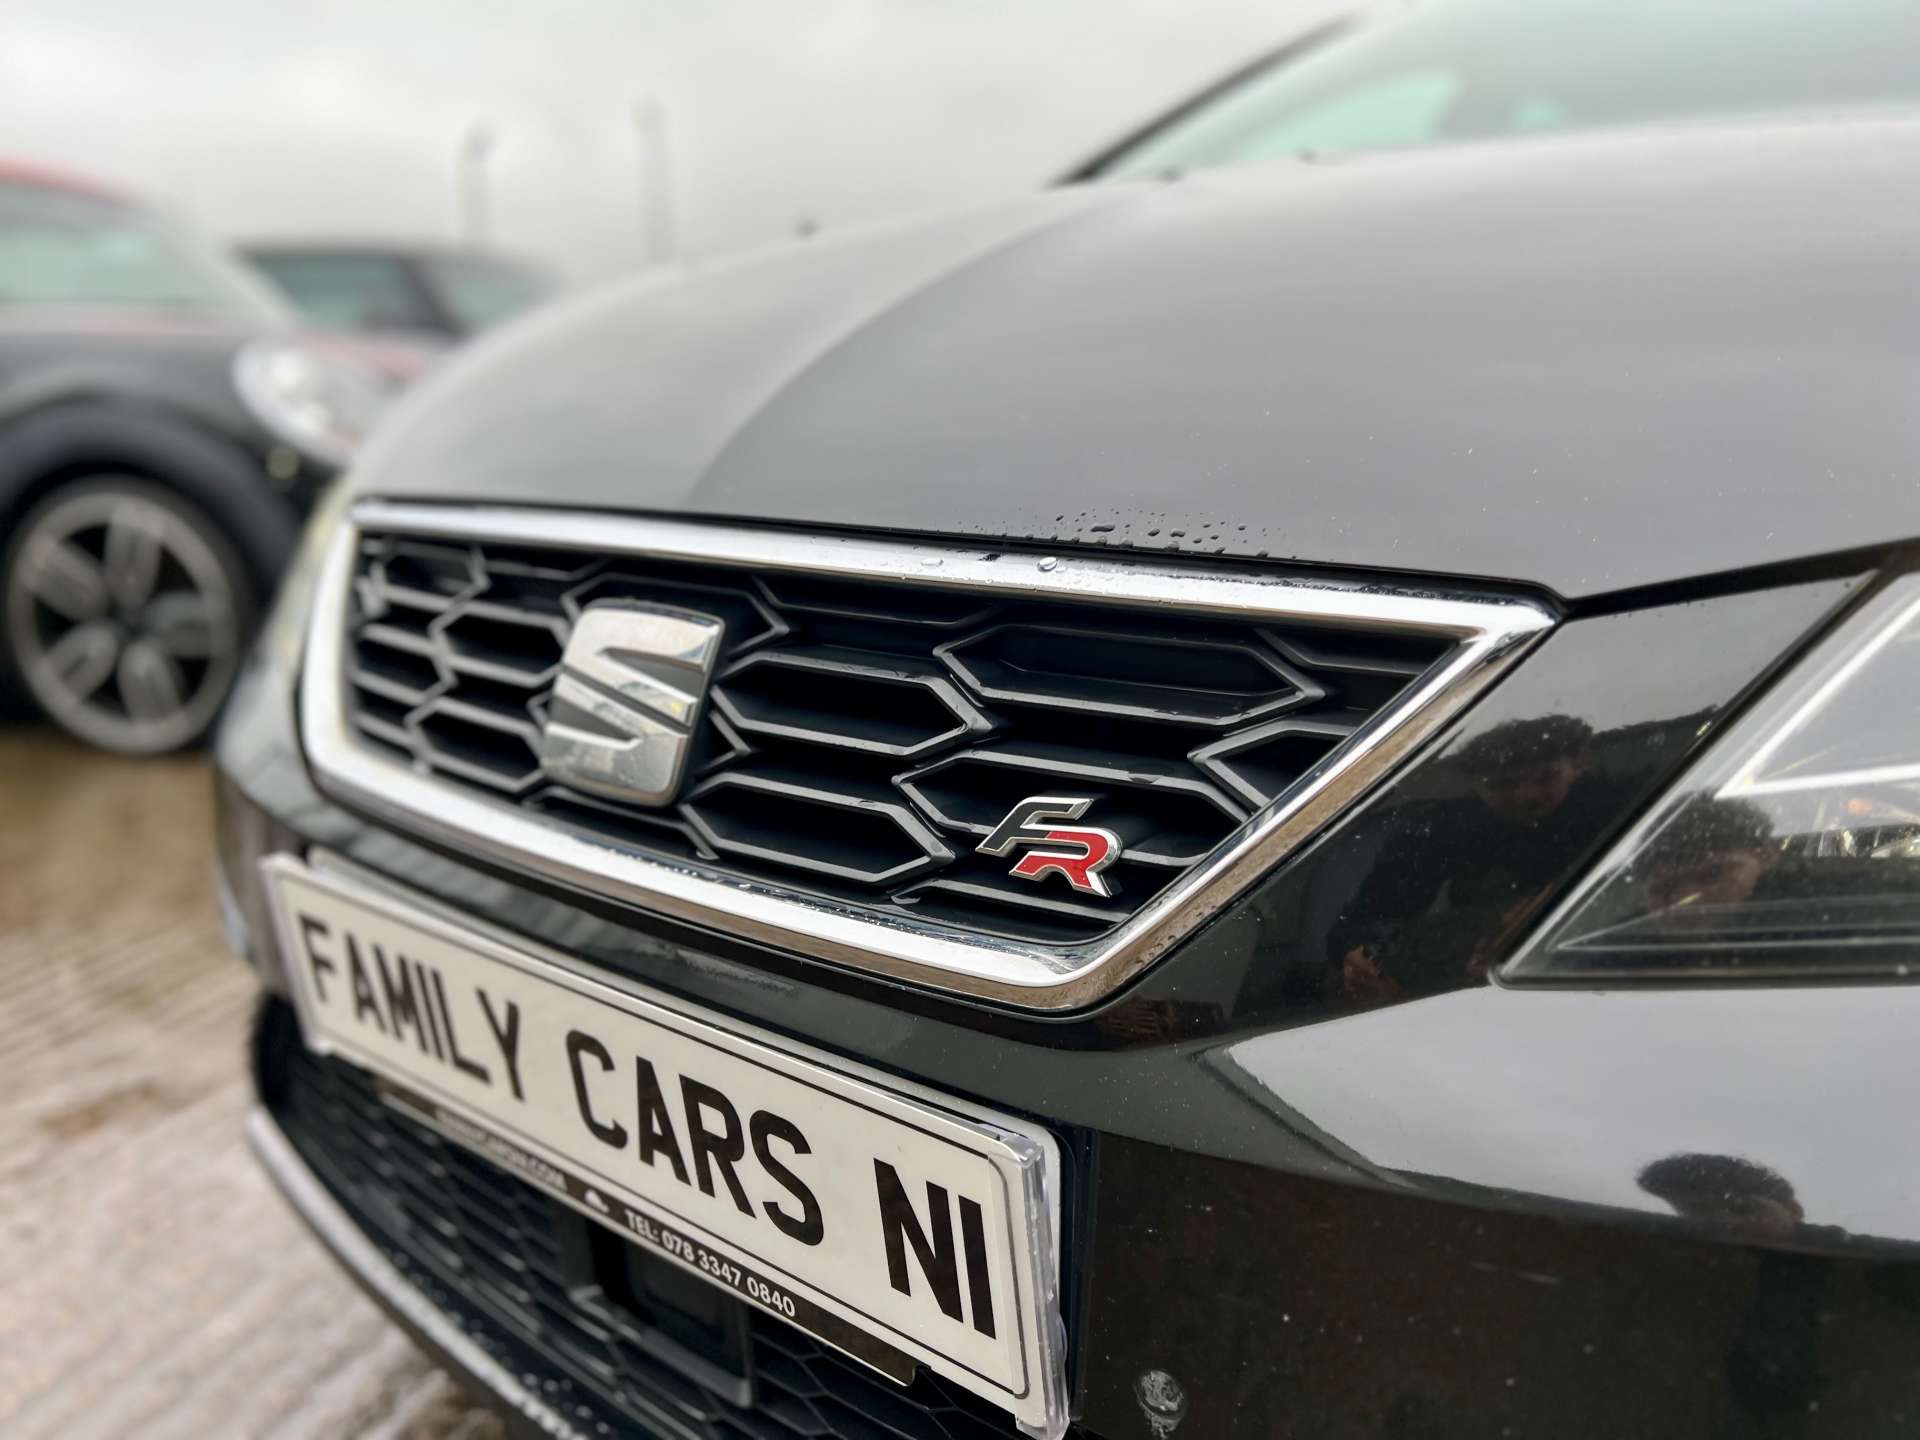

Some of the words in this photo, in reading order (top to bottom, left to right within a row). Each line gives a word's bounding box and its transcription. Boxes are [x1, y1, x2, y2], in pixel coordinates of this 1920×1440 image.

[975, 796, 1123, 898] FR
[297, 914, 526, 1101] FAMILY
[566, 1029, 824, 1246] CARS
[874, 1158, 997, 1340] NI
[624, 1208, 660, 1243] TEL:
[661, 1229, 695, 1262] 078
[698, 1250, 741, 1287] 3347
[746, 1276, 796, 1317] 0840
